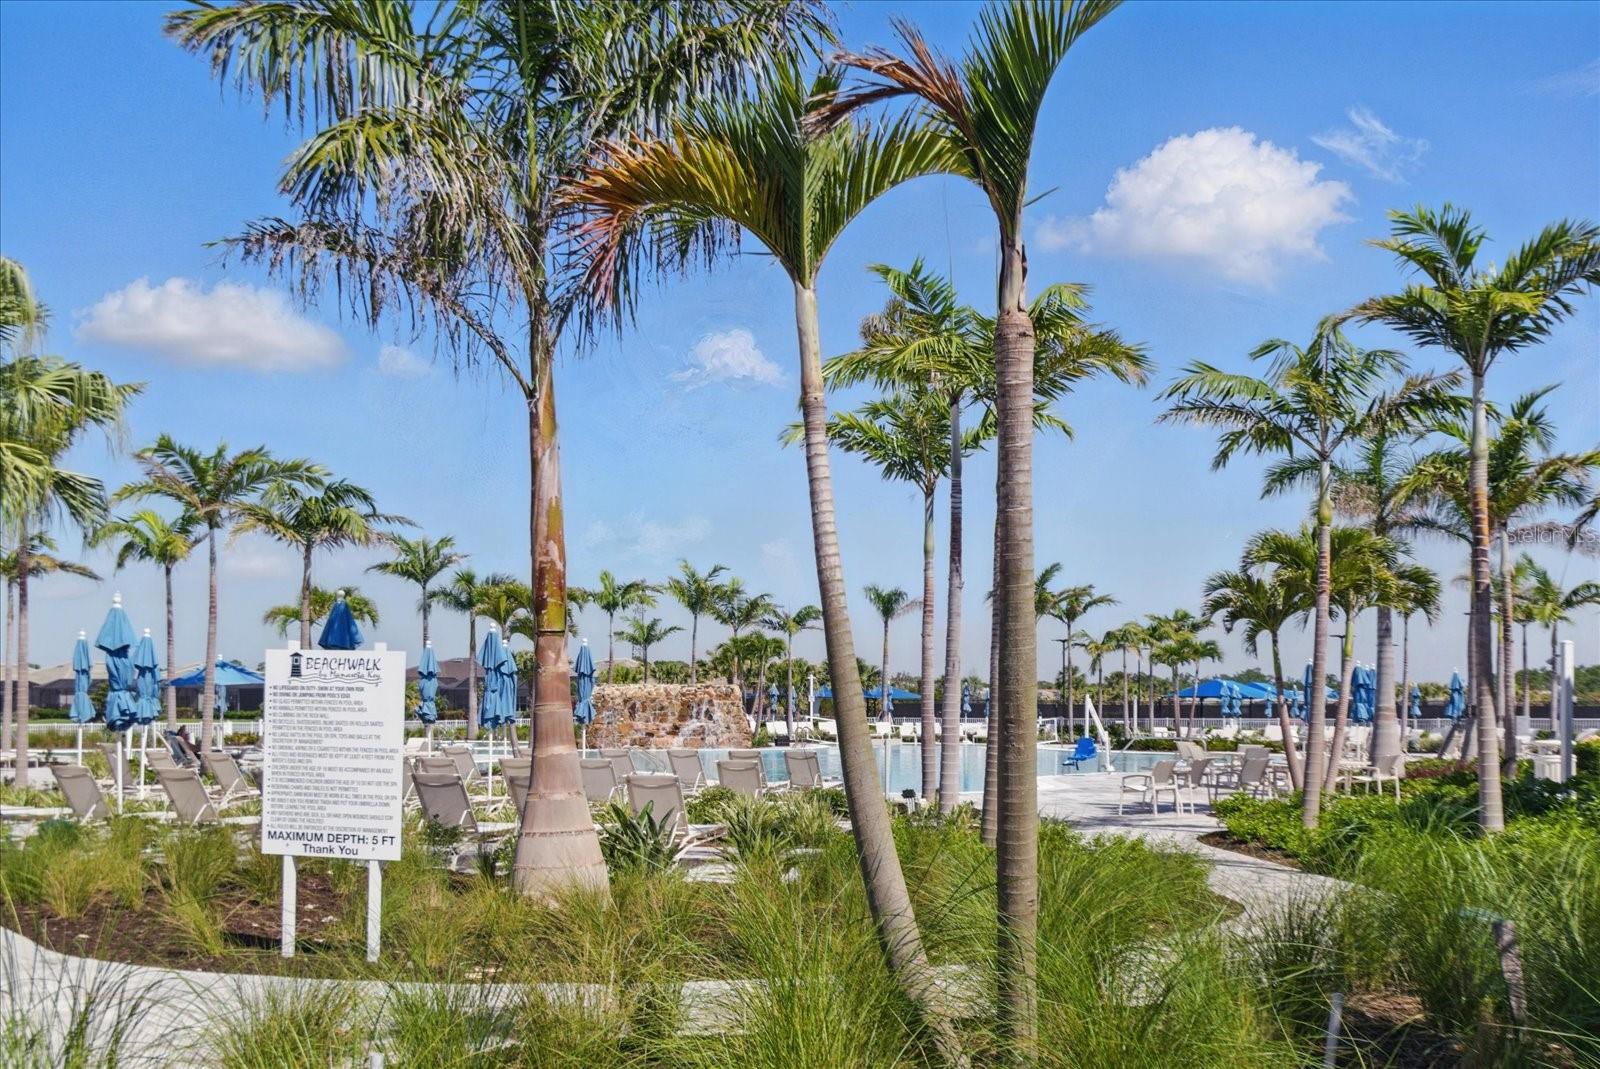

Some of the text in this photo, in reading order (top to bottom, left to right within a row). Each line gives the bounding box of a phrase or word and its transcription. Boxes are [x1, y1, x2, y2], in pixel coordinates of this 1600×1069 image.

[306, 657, 381, 670] BEACHWALK
[267, 830, 396, 846] MAXIMUM DEPTH: 5 FT
[302, 843, 359, 856] Thank You
